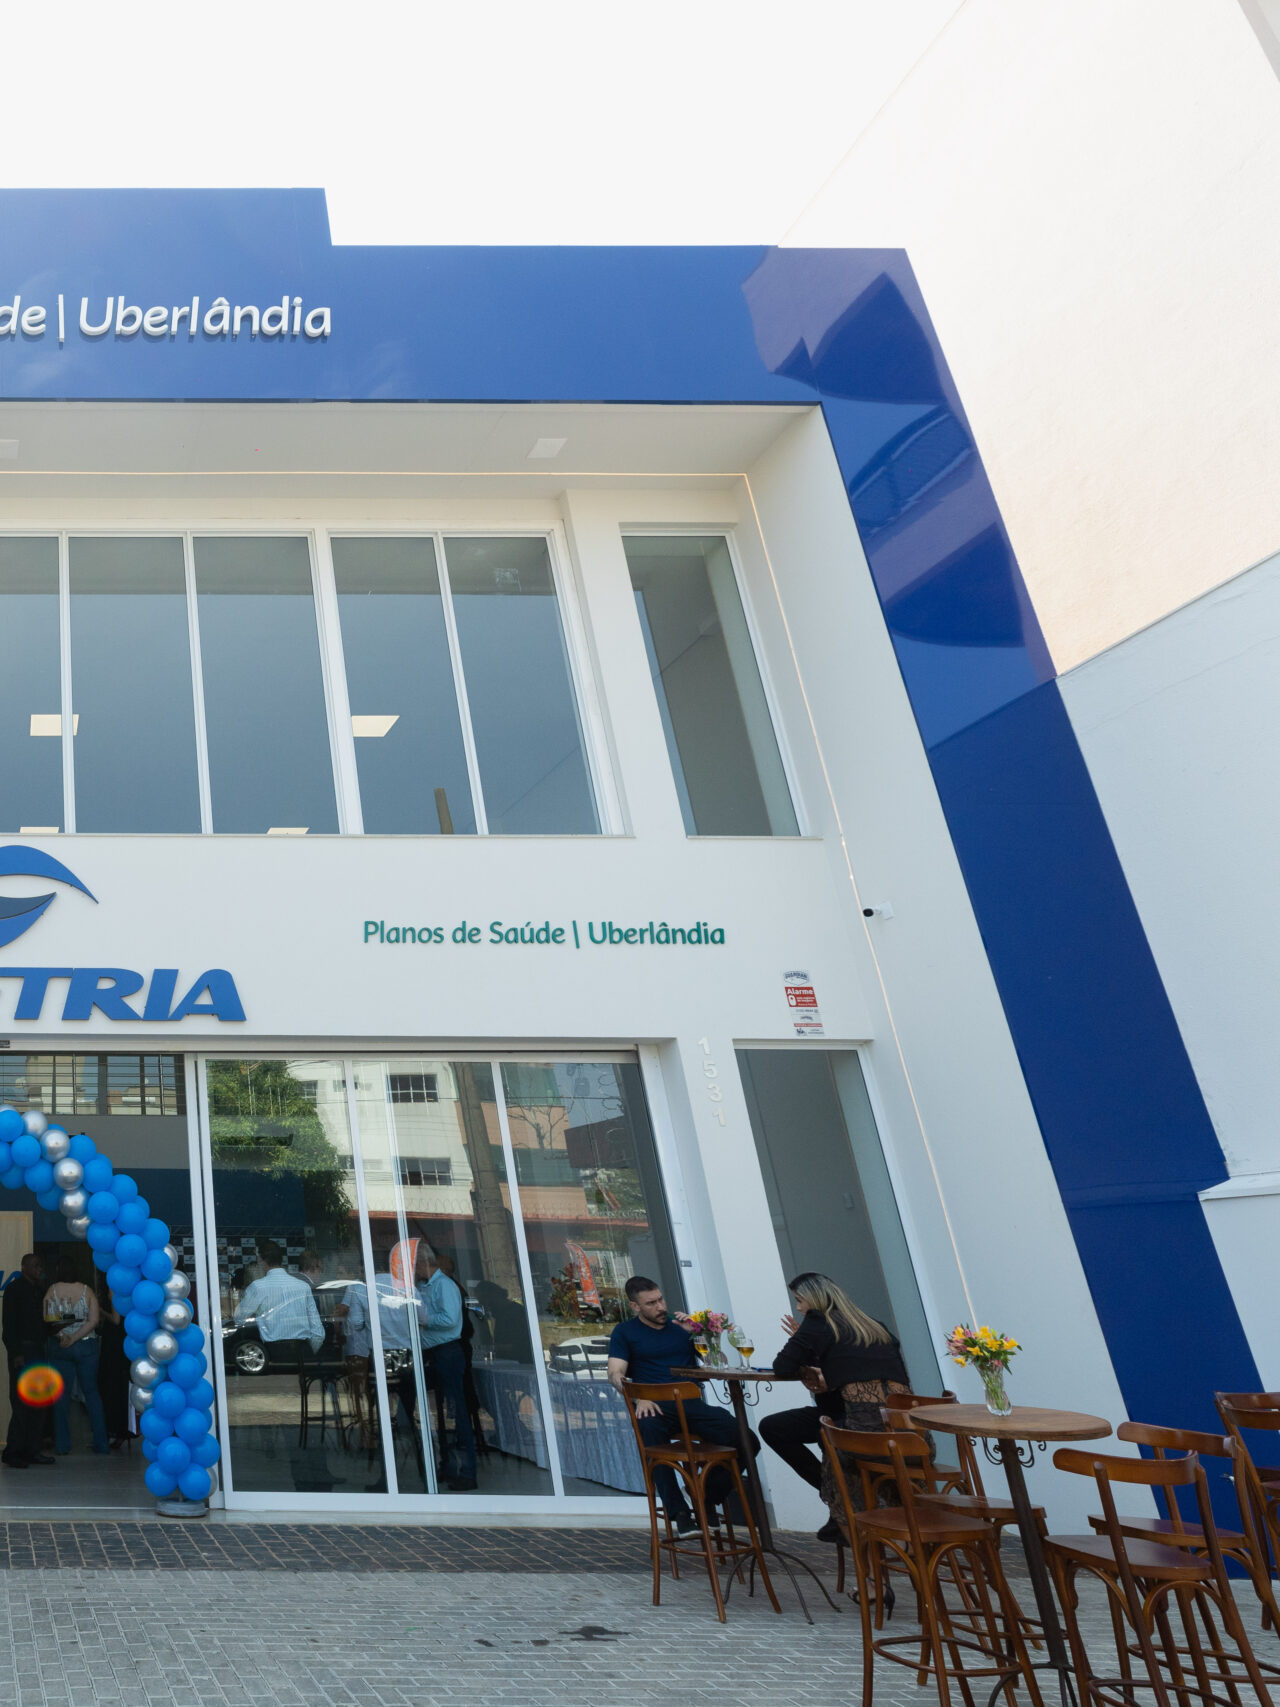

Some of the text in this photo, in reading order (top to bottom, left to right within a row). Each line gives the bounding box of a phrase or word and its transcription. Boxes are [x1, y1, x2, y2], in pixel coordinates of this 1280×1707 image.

[78, 296, 332, 338] Uberlândia
[364, 920, 445, 944] Planos
[451, 920, 482, 944] de
[488, 920, 566, 945] Saúde
[587, 920, 726, 945] Uberlândia
[698, 1036, 726, 1127] 1531
